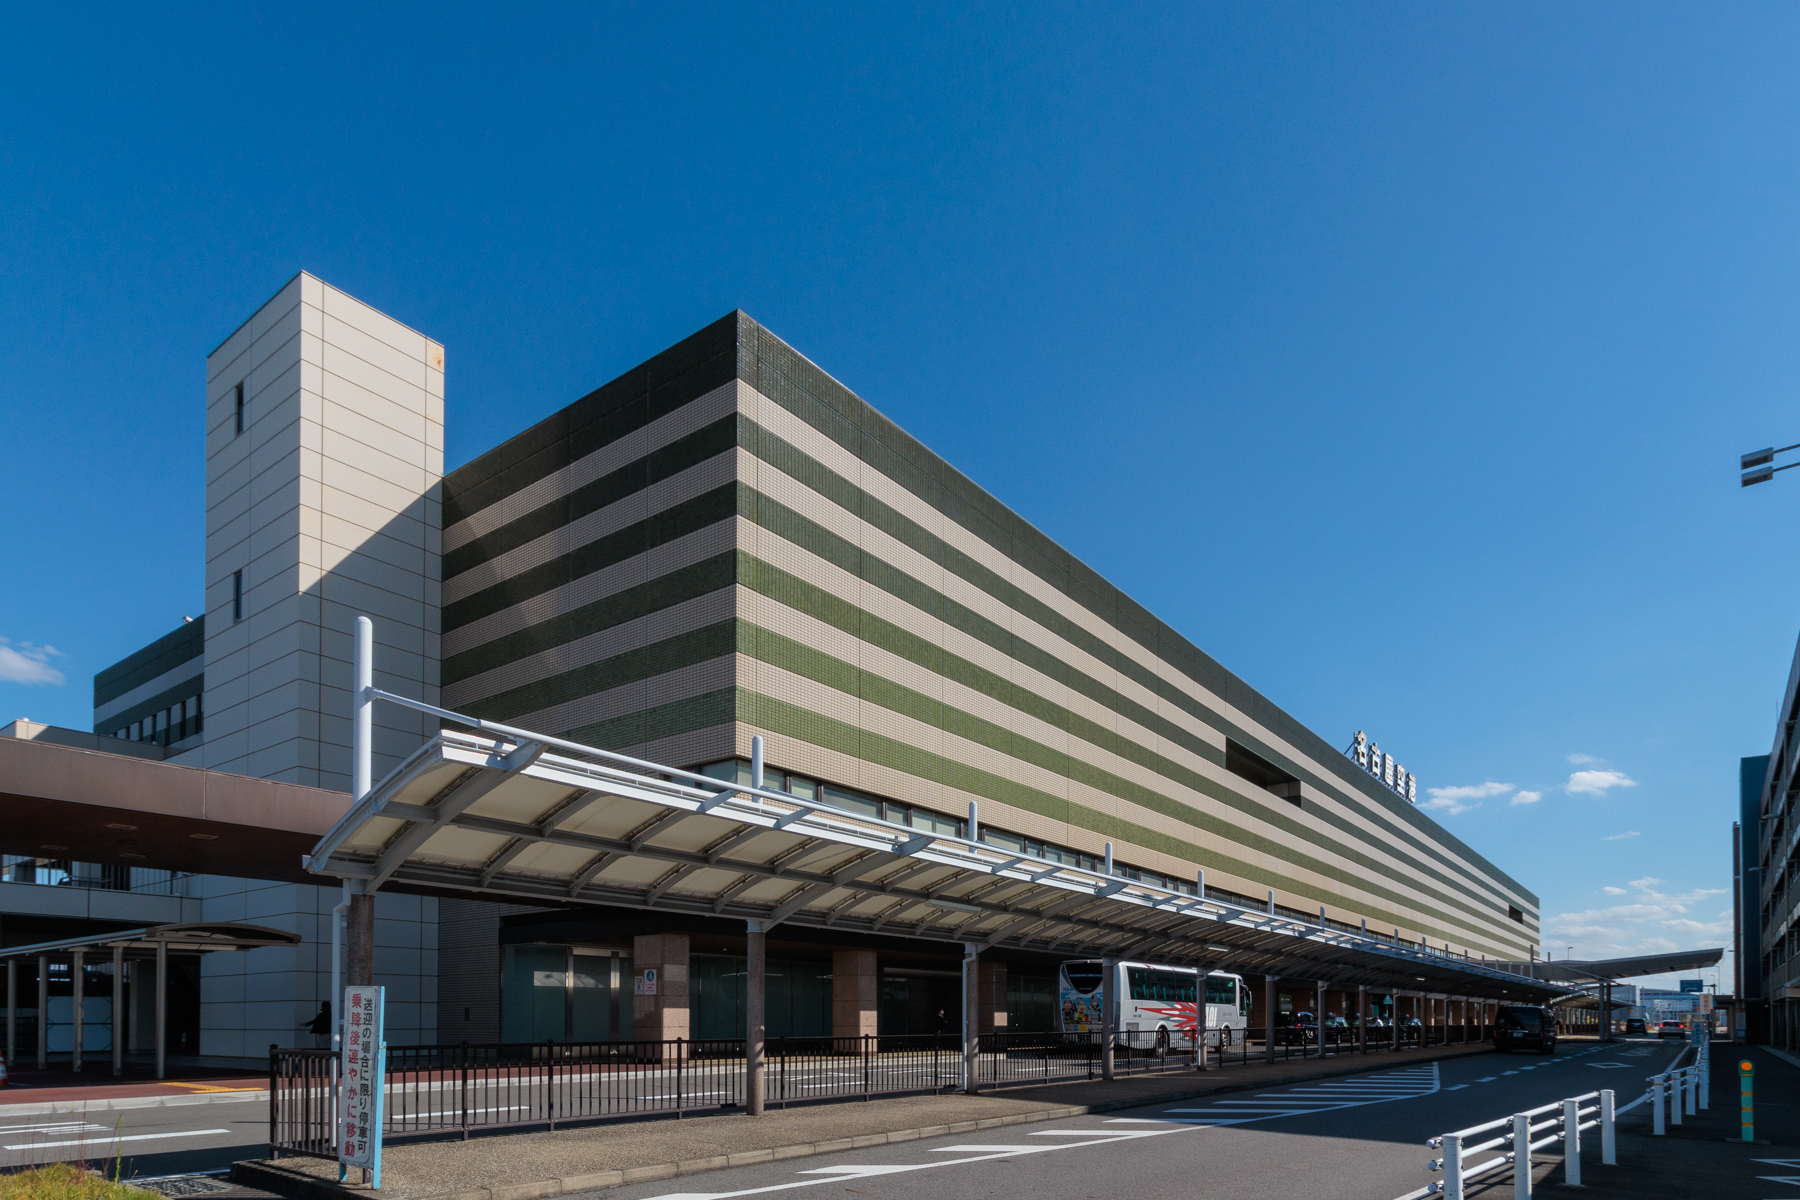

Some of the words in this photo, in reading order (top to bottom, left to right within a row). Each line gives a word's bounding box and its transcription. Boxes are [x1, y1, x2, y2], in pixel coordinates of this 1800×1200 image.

[1354, 730, 1417, 803] 名古屋空港
[343, 993, 362, 1157] 乗降後速やかに移動
[357, 997, 373, 1154] 送迎の場合に限り停車可
